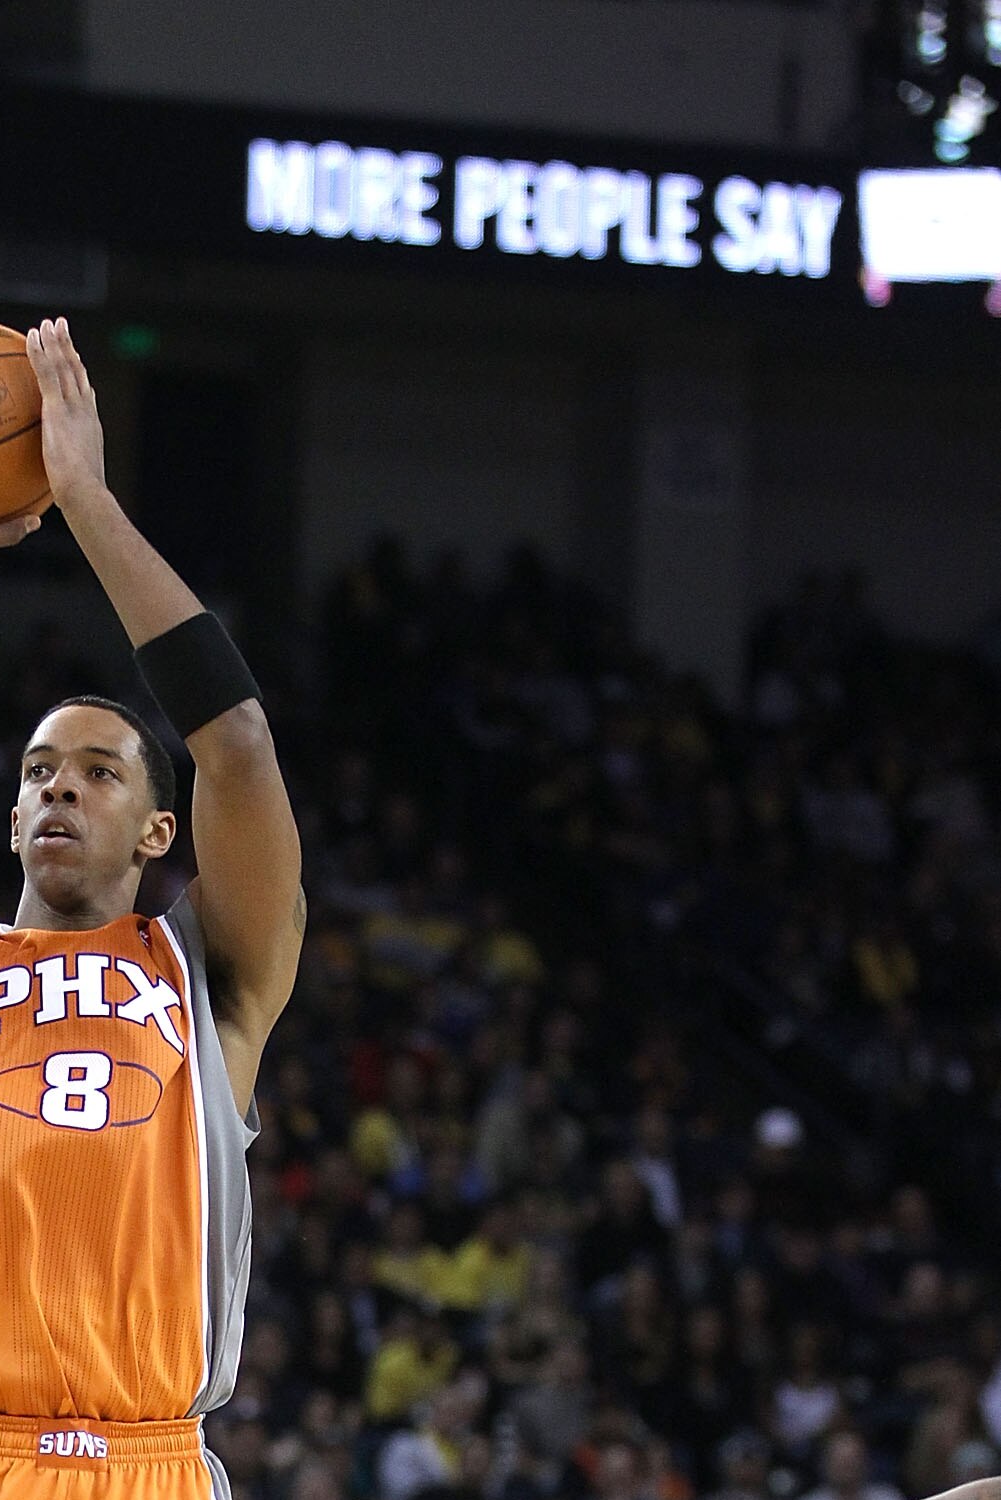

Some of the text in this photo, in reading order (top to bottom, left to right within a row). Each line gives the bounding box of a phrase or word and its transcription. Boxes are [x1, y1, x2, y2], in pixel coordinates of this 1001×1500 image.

[247, 138, 842, 279] MORE PEOPLE SAY
[40, 1051, 113, 1131] 8
[39, 1430, 108, 1459] SUNS
